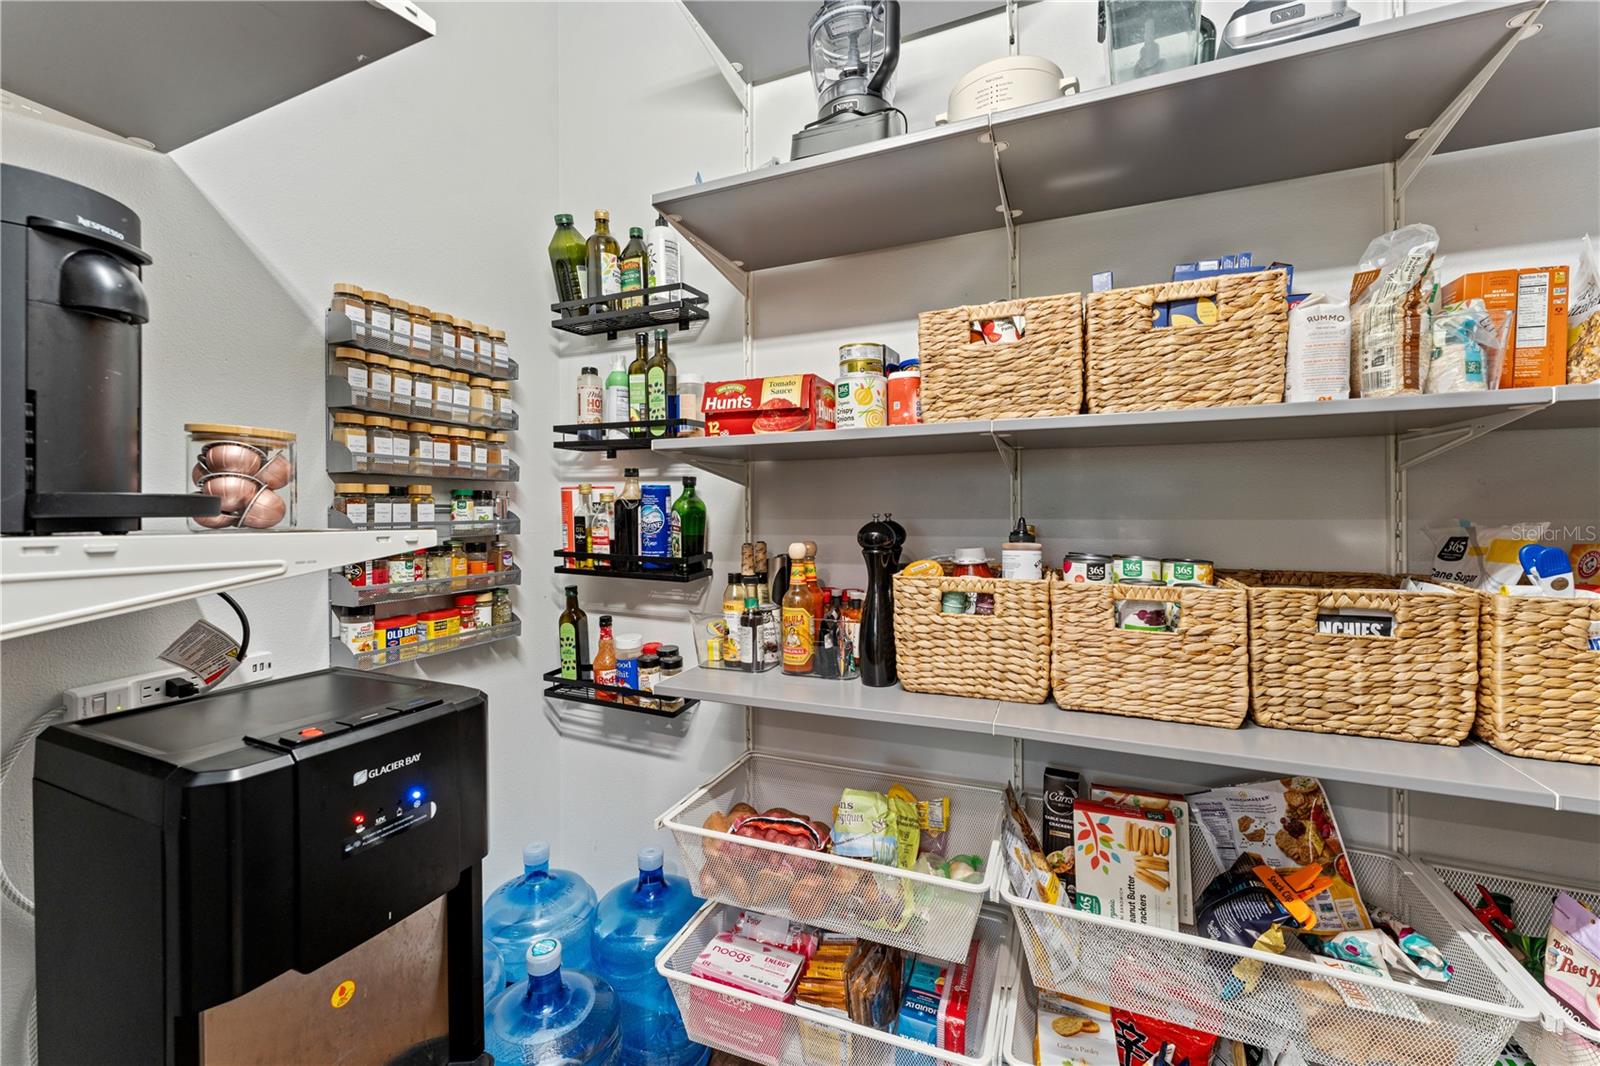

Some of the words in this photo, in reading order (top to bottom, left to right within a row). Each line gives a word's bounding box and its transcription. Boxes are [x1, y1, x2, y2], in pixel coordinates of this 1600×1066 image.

[836, 102, 854, 111] NINJA
[76, 215, 124, 240] NESPRESSO
[1307, 314, 1345, 323] RUMMO
[769, 380, 796, 388] Tomato
[705, 395, 752, 410] Hunt's
[818, 399, 834, 421] Hun
[708, 421, 720, 433] 12
[1444, 540, 1467, 553] 365
[1088, 566, 1104, 575] 365
[1124, 563, 1141, 572] 365
[1175, 566, 1192, 575] 365
[1454, 571, 1478, 583] Sugar
[387, 628, 403, 640] OLD
[404, 626, 417, 637] BAY
[1319, 620, 1381, 637] NCHIES
[368, 758, 405, 779] GLACIER
[405, 752, 422, 766] BAY
[840, 801, 854, 809] ns
[839, 813, 864, 825] giques
[1126, 875, 1136, 900] Butter
[1267, 876, 1285, 892] Snack
[1127, 901, 1137, 924] eanut
[1138, 894, 1148, 924] rackers
[712, 944, 752, 963] noogs
[764, 956, 791, 969] ENERGY
[1557, 955, 1589, 978] Red
